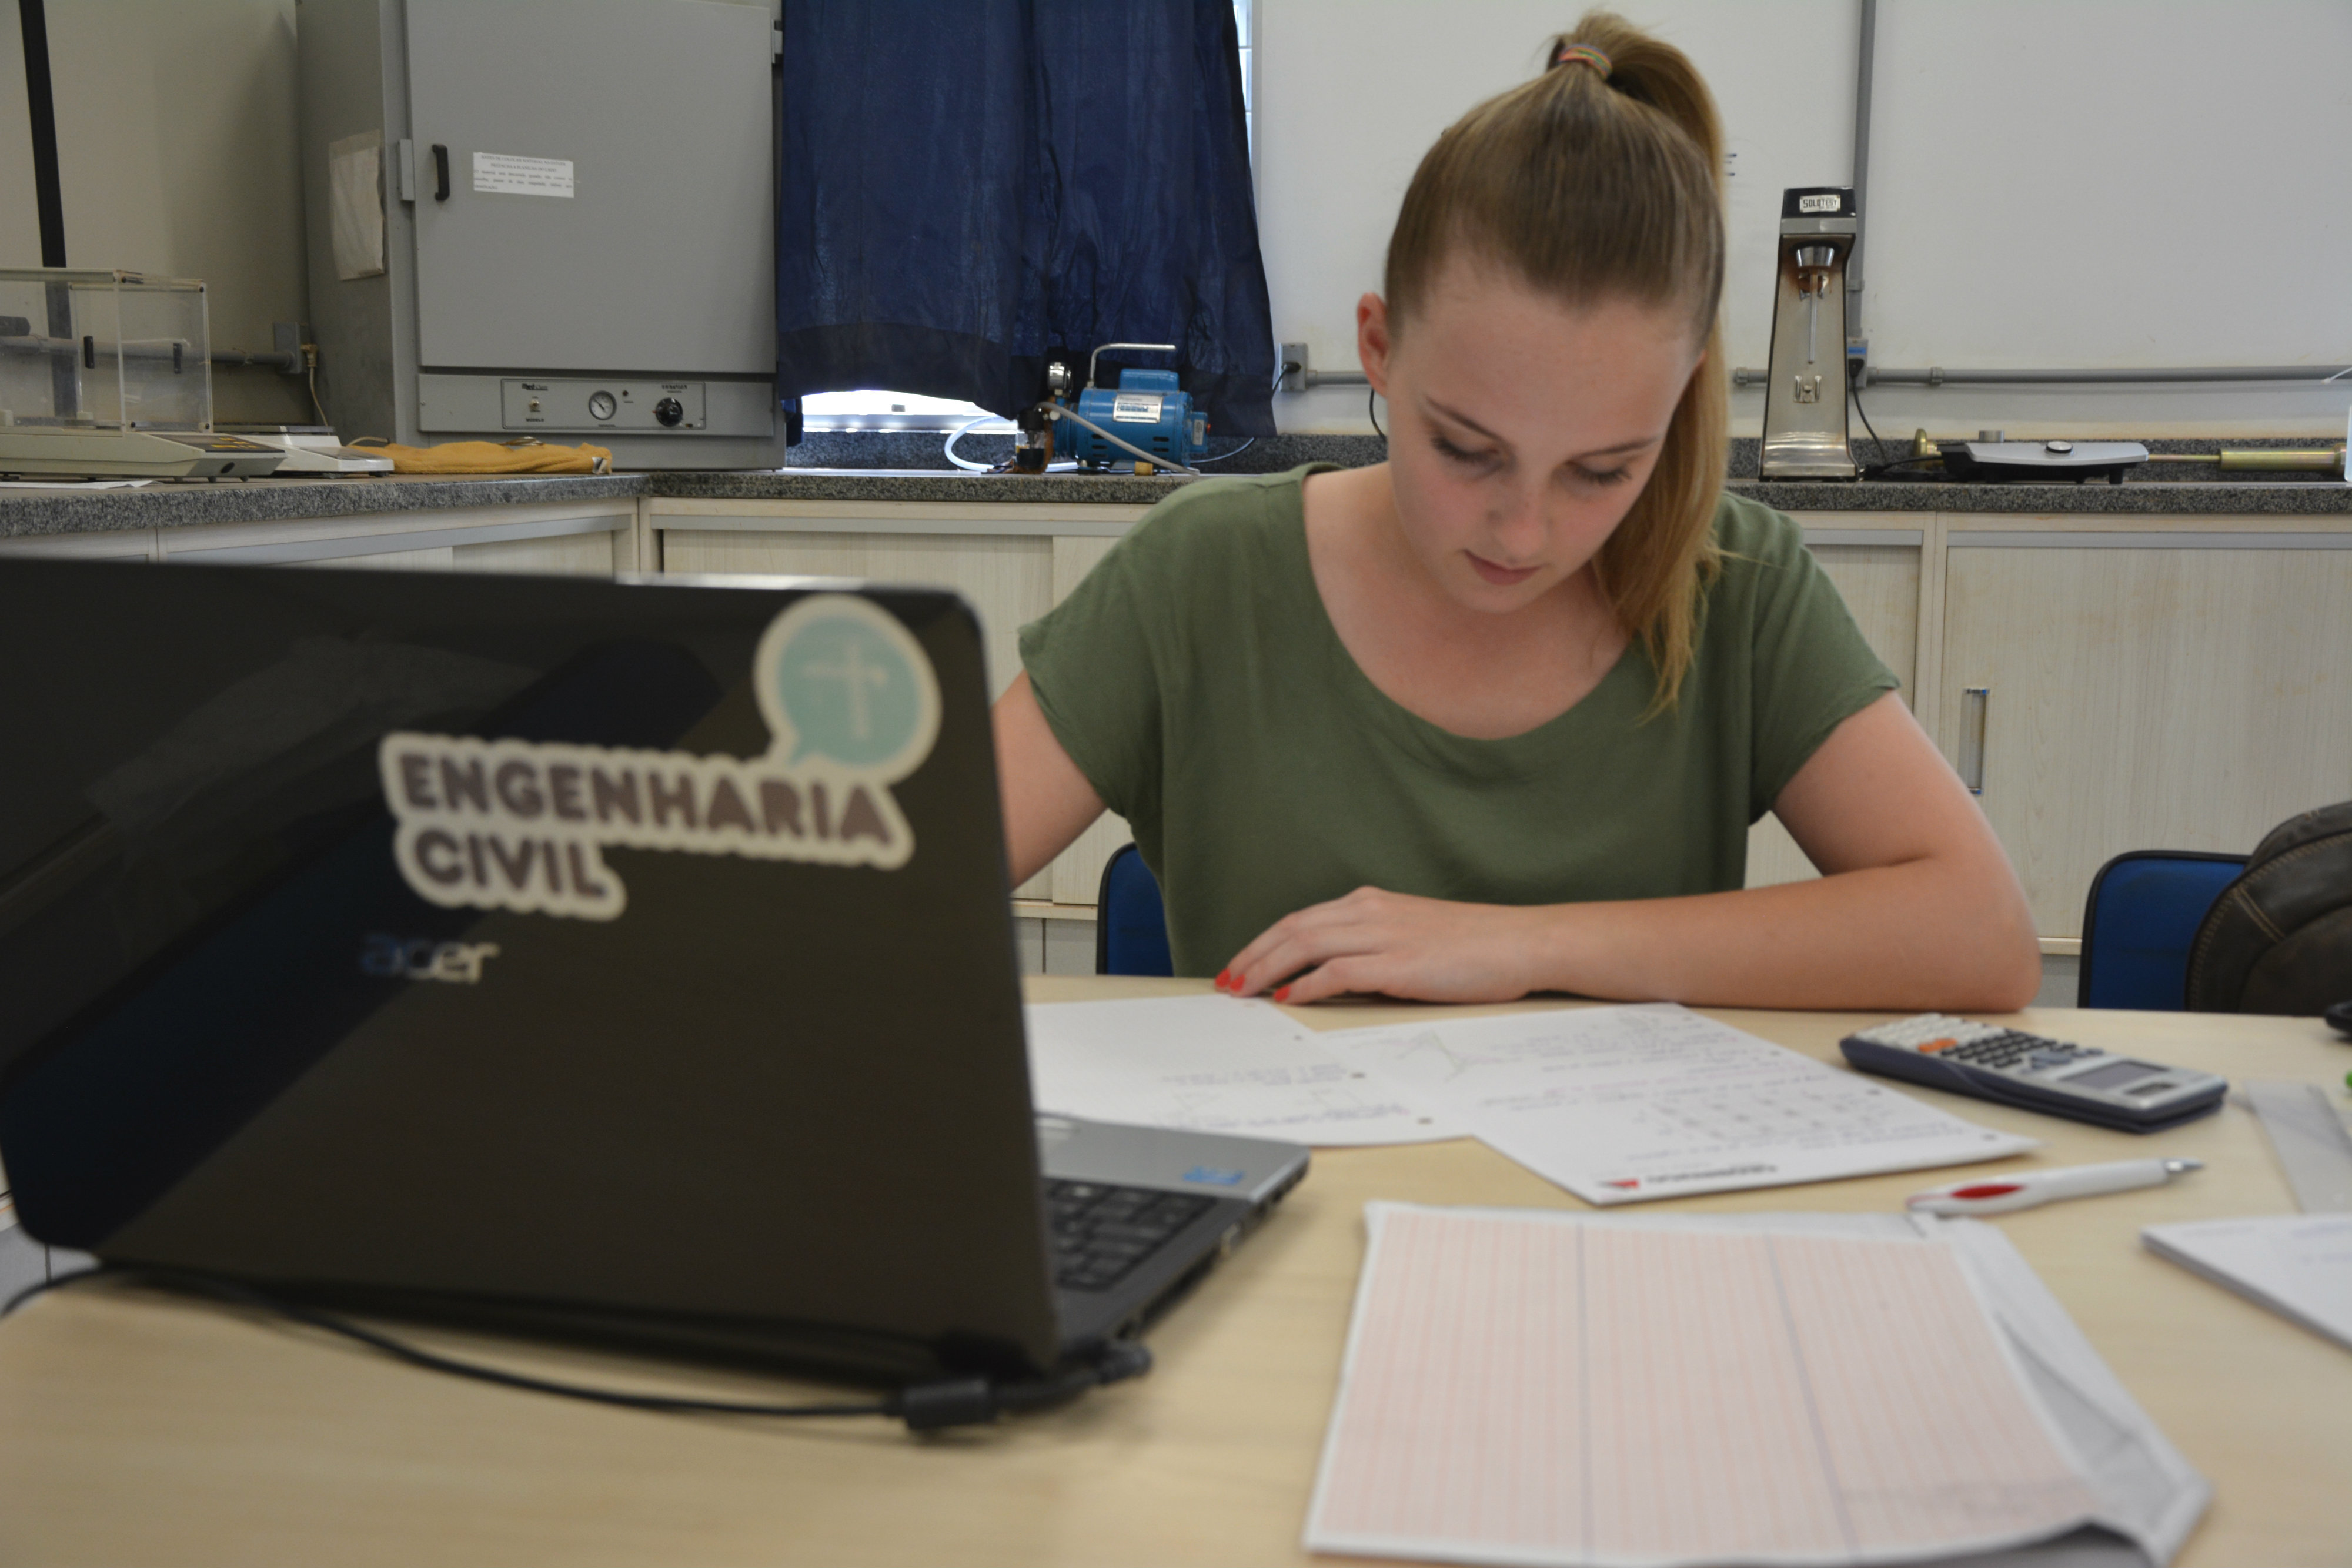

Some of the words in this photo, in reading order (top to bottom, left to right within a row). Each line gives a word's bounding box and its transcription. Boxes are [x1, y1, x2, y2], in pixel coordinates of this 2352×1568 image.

[1803, 199, 1836, 208] SOLOTEST
[397, 751, 896, 847] ENGENHARIA
[413, 829, 610, 901] CIVIL
[361, 934, 500, 984] acer
